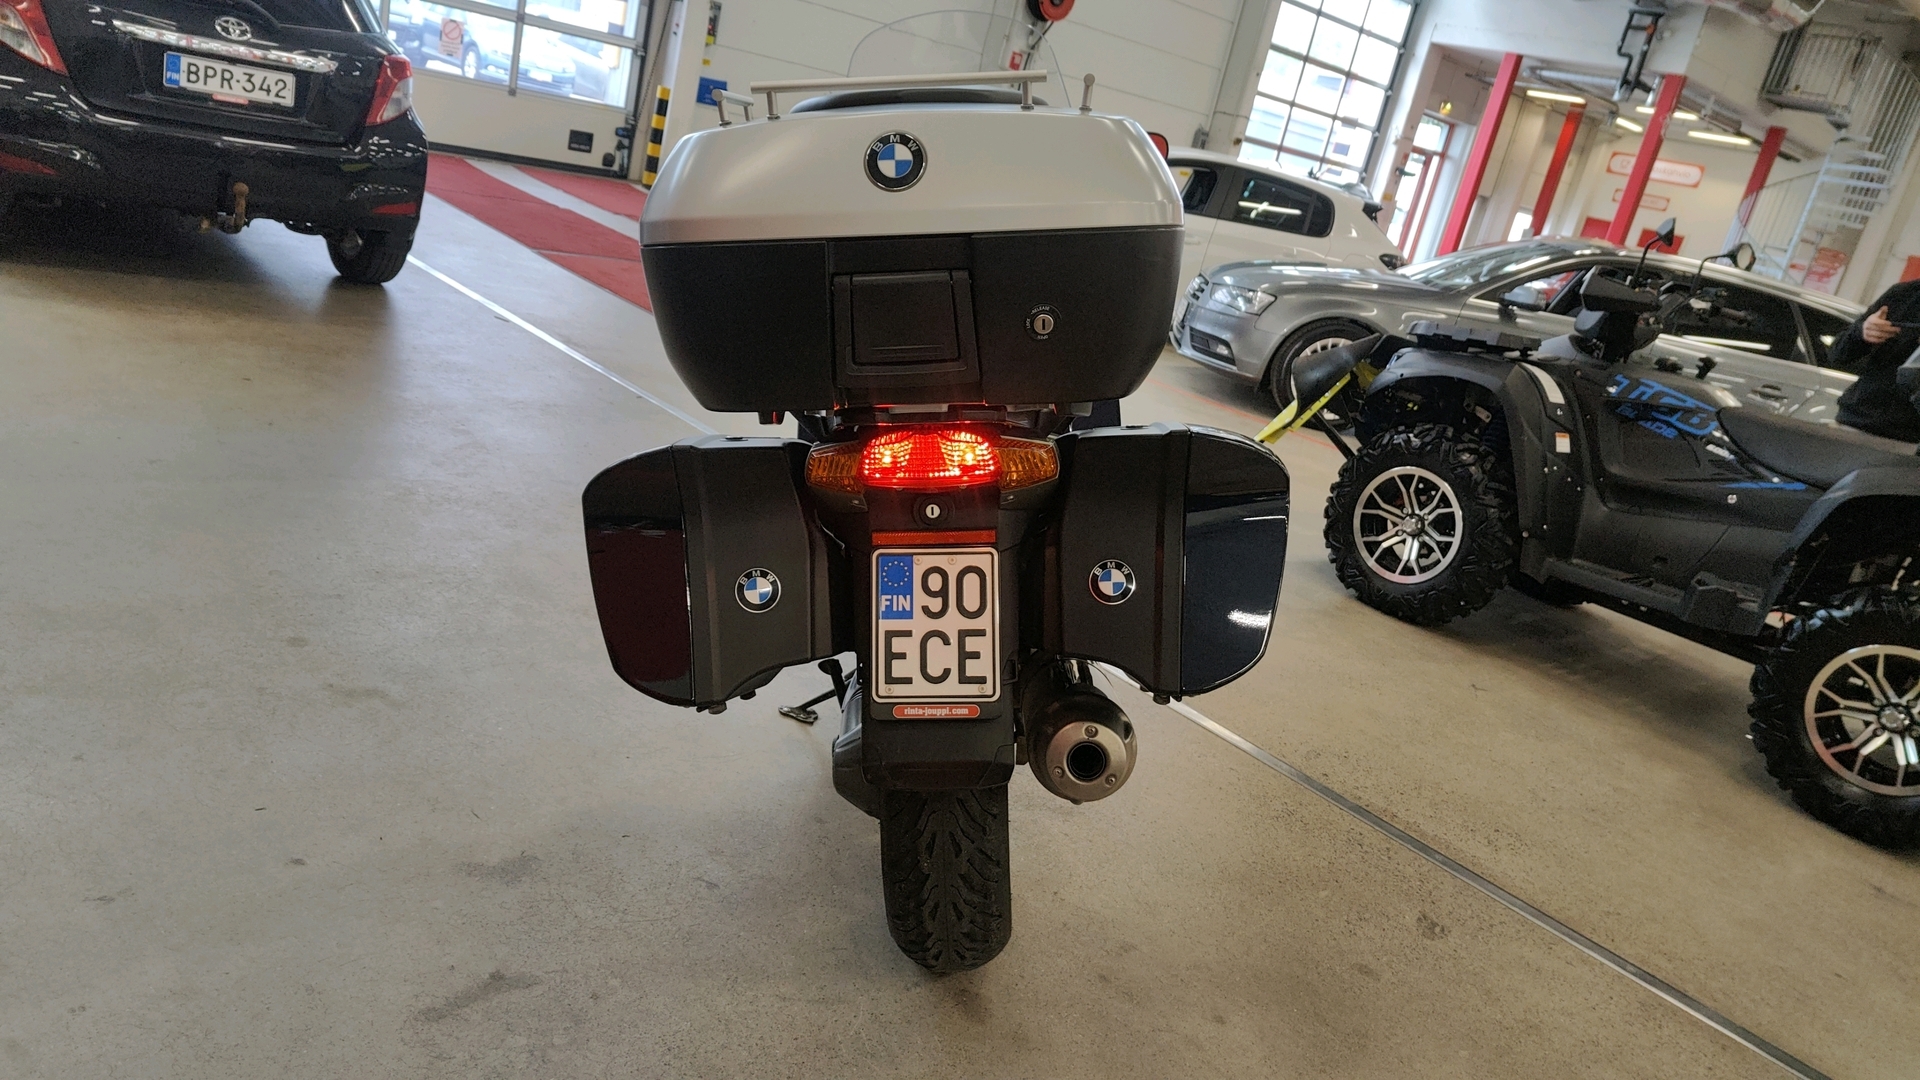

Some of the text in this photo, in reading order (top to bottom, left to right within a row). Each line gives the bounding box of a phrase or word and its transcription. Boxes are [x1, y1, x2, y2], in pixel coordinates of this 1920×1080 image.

[186, 62, 287, 99] BPR-342
[872, 134, 919, 152] BMW
[740, 570, 776, 585] BMW
[1093, 561, 1130, 576] BMW
[881, 565, 988, 620] FIN 90
[884, 628, 988, 685] ECE
[904, 706, 969, 716] rinta-jouppi.com
